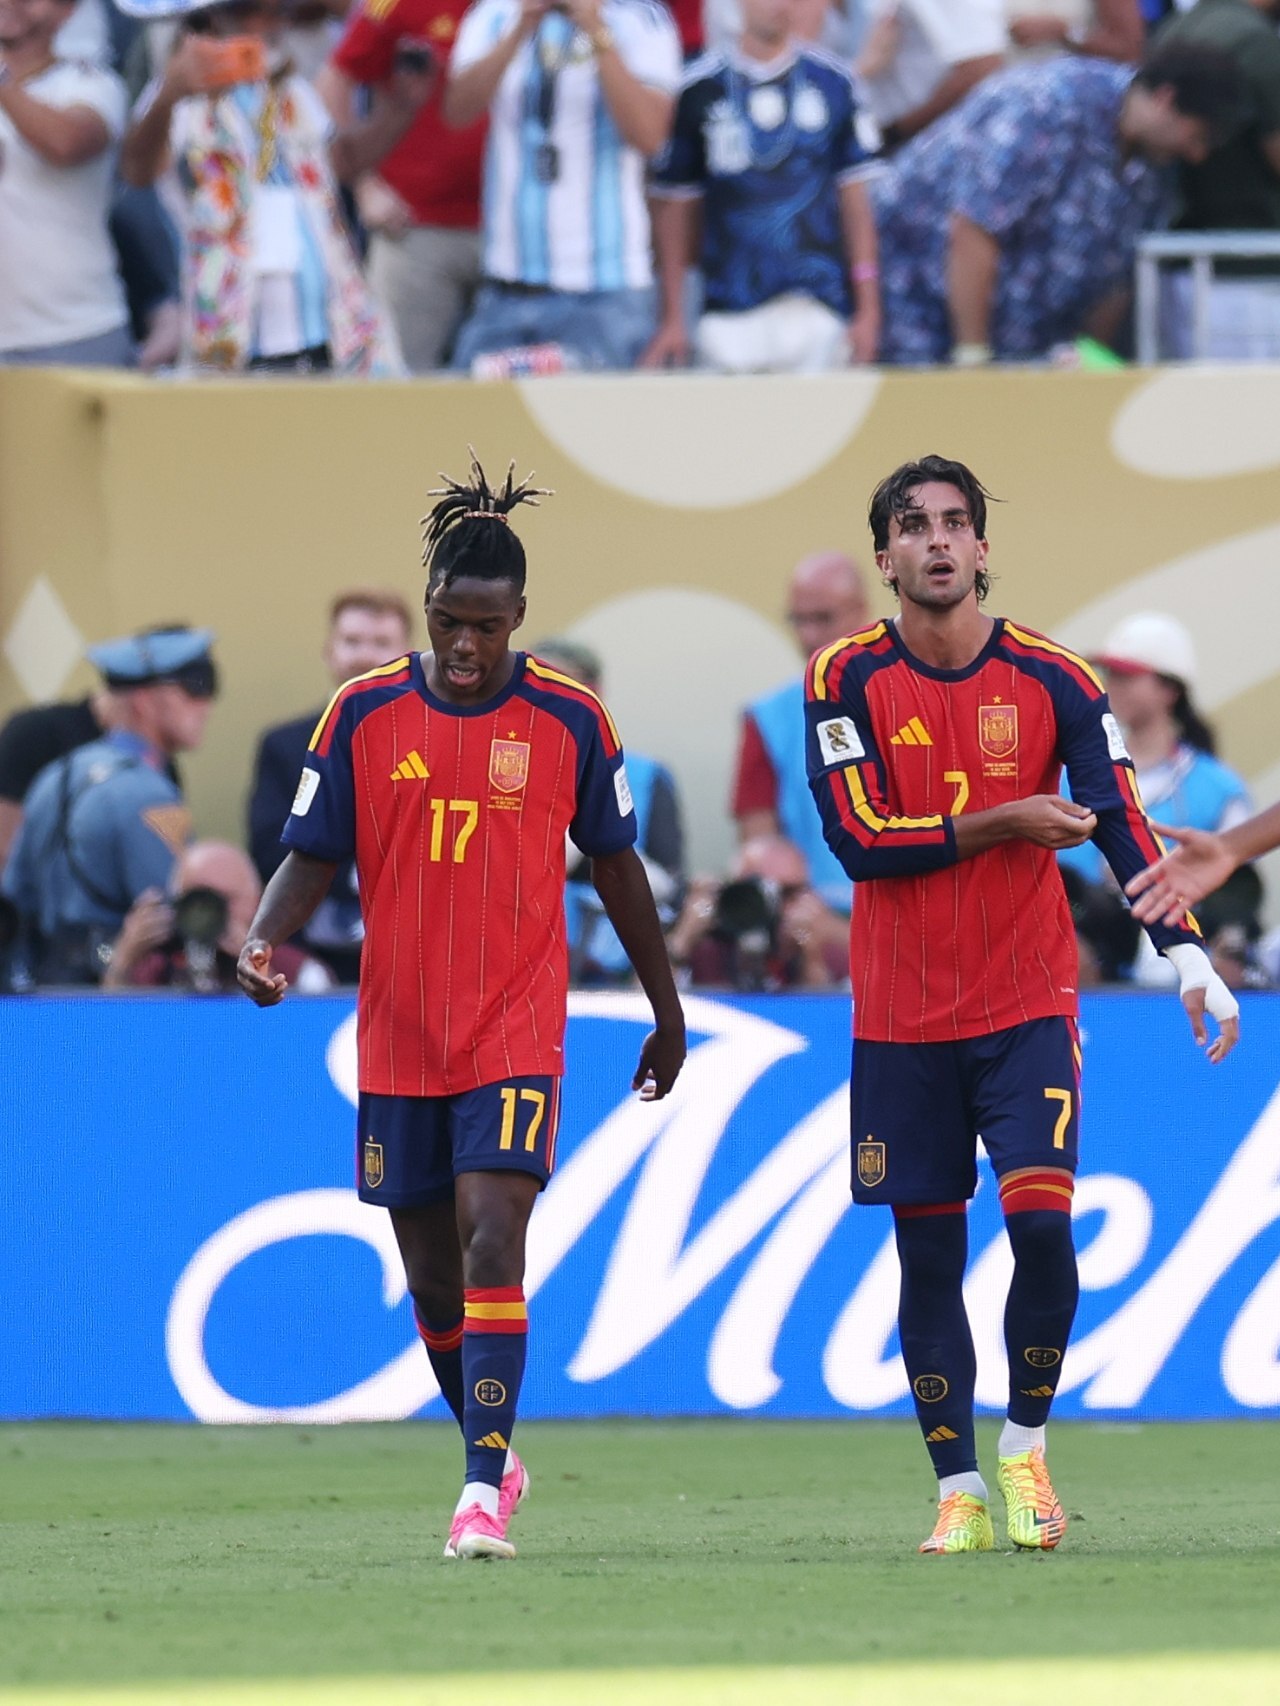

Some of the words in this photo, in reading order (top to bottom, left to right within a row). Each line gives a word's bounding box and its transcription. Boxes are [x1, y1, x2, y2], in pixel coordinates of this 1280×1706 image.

[944, 771, 970, 815] 7
[430, 799, 479, 863] 17
[499, 1088, 546, 1153] 17
[1044, 1087, 1073, 1149] 7
